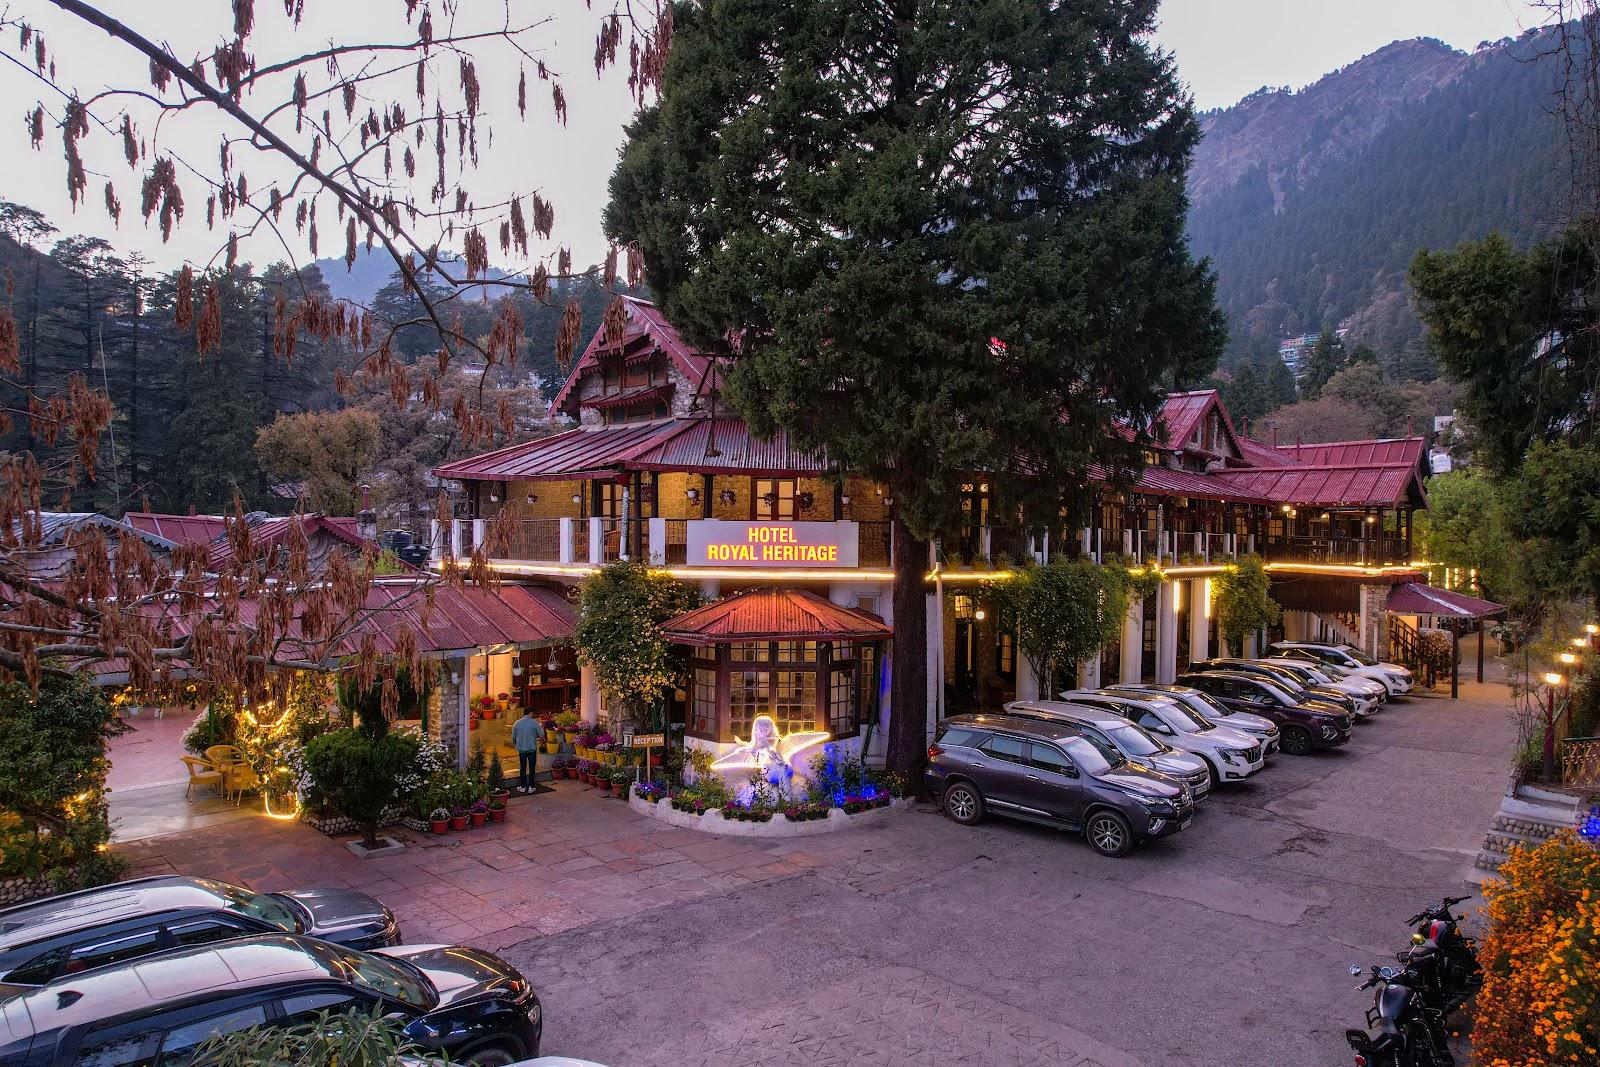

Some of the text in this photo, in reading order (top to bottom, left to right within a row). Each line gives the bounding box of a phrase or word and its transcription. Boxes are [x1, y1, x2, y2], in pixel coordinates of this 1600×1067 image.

[748, 527, 797, 543] HOTEL
[708, 544, 837, 561] ROYAL HERITAGE
[633, 736, 662, 745] RECEPTION
